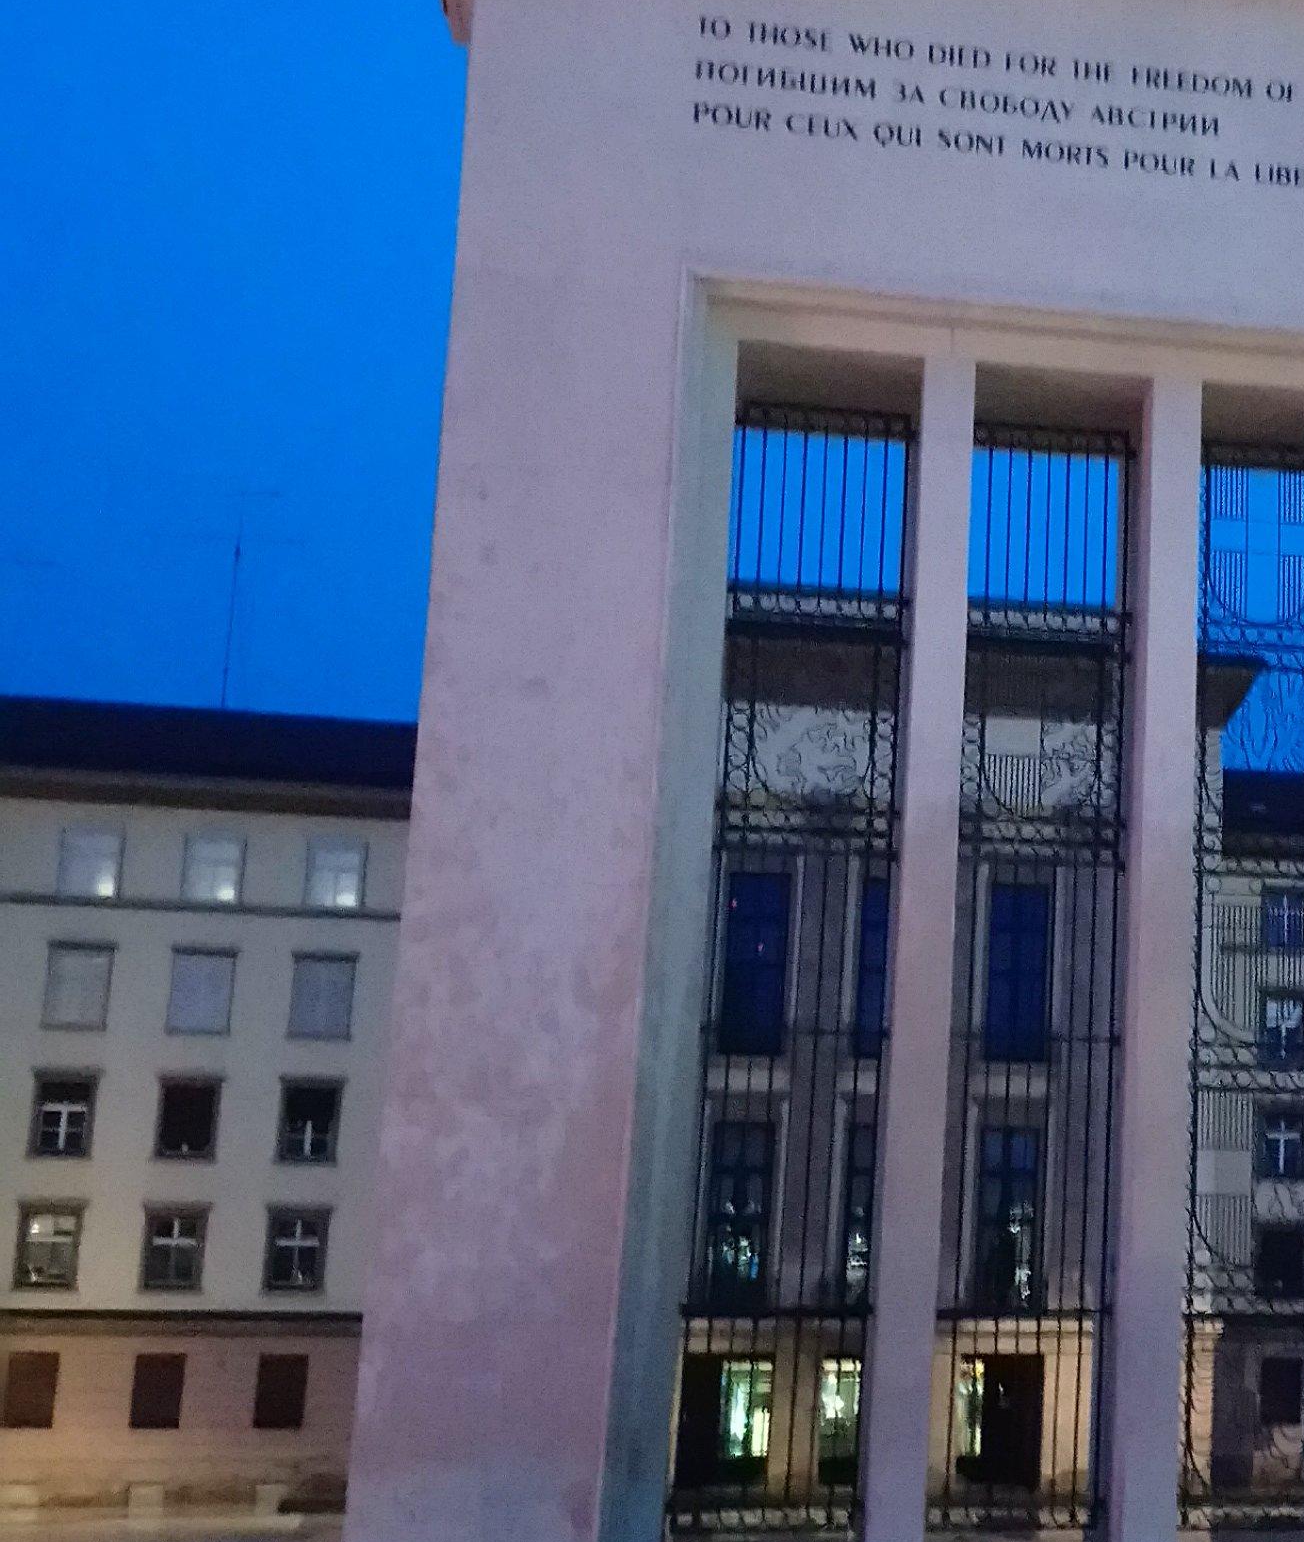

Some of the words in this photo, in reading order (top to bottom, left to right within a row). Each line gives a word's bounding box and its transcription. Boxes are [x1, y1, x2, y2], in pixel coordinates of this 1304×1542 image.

[694, 59, 877, 101] ПОГИБШИМ
[898, 82, 925, 105] ЗА
[938, 88, 1075, 124] СВОБОДУ
[1090, 104, 1220, 137] АВСТРИИ
[699, 15, 732, 41] TO
[747, 21, 831, 53] THOSE
[848, 32, 915, 60] WHO
[927, 43, 993, 69] DIED
[1005, 50, 1058, 78] FOR
[1072, 58, 1113, 84] THE
[1131, 65, 1254, 100] FREEDOM
[1265, 80, 1295, 104] OF
[692, 101, 773, 133] POUR
[784, 113, 859, 142] CEUX
[872, 122, 922, 149] QUI
[937, 128, 1006, 157] SONT
[1021, 138, 1110, 169] MORTS
[1123, 148, 1197, 177] POUR
[1209, 158, 1241, 182] LA
